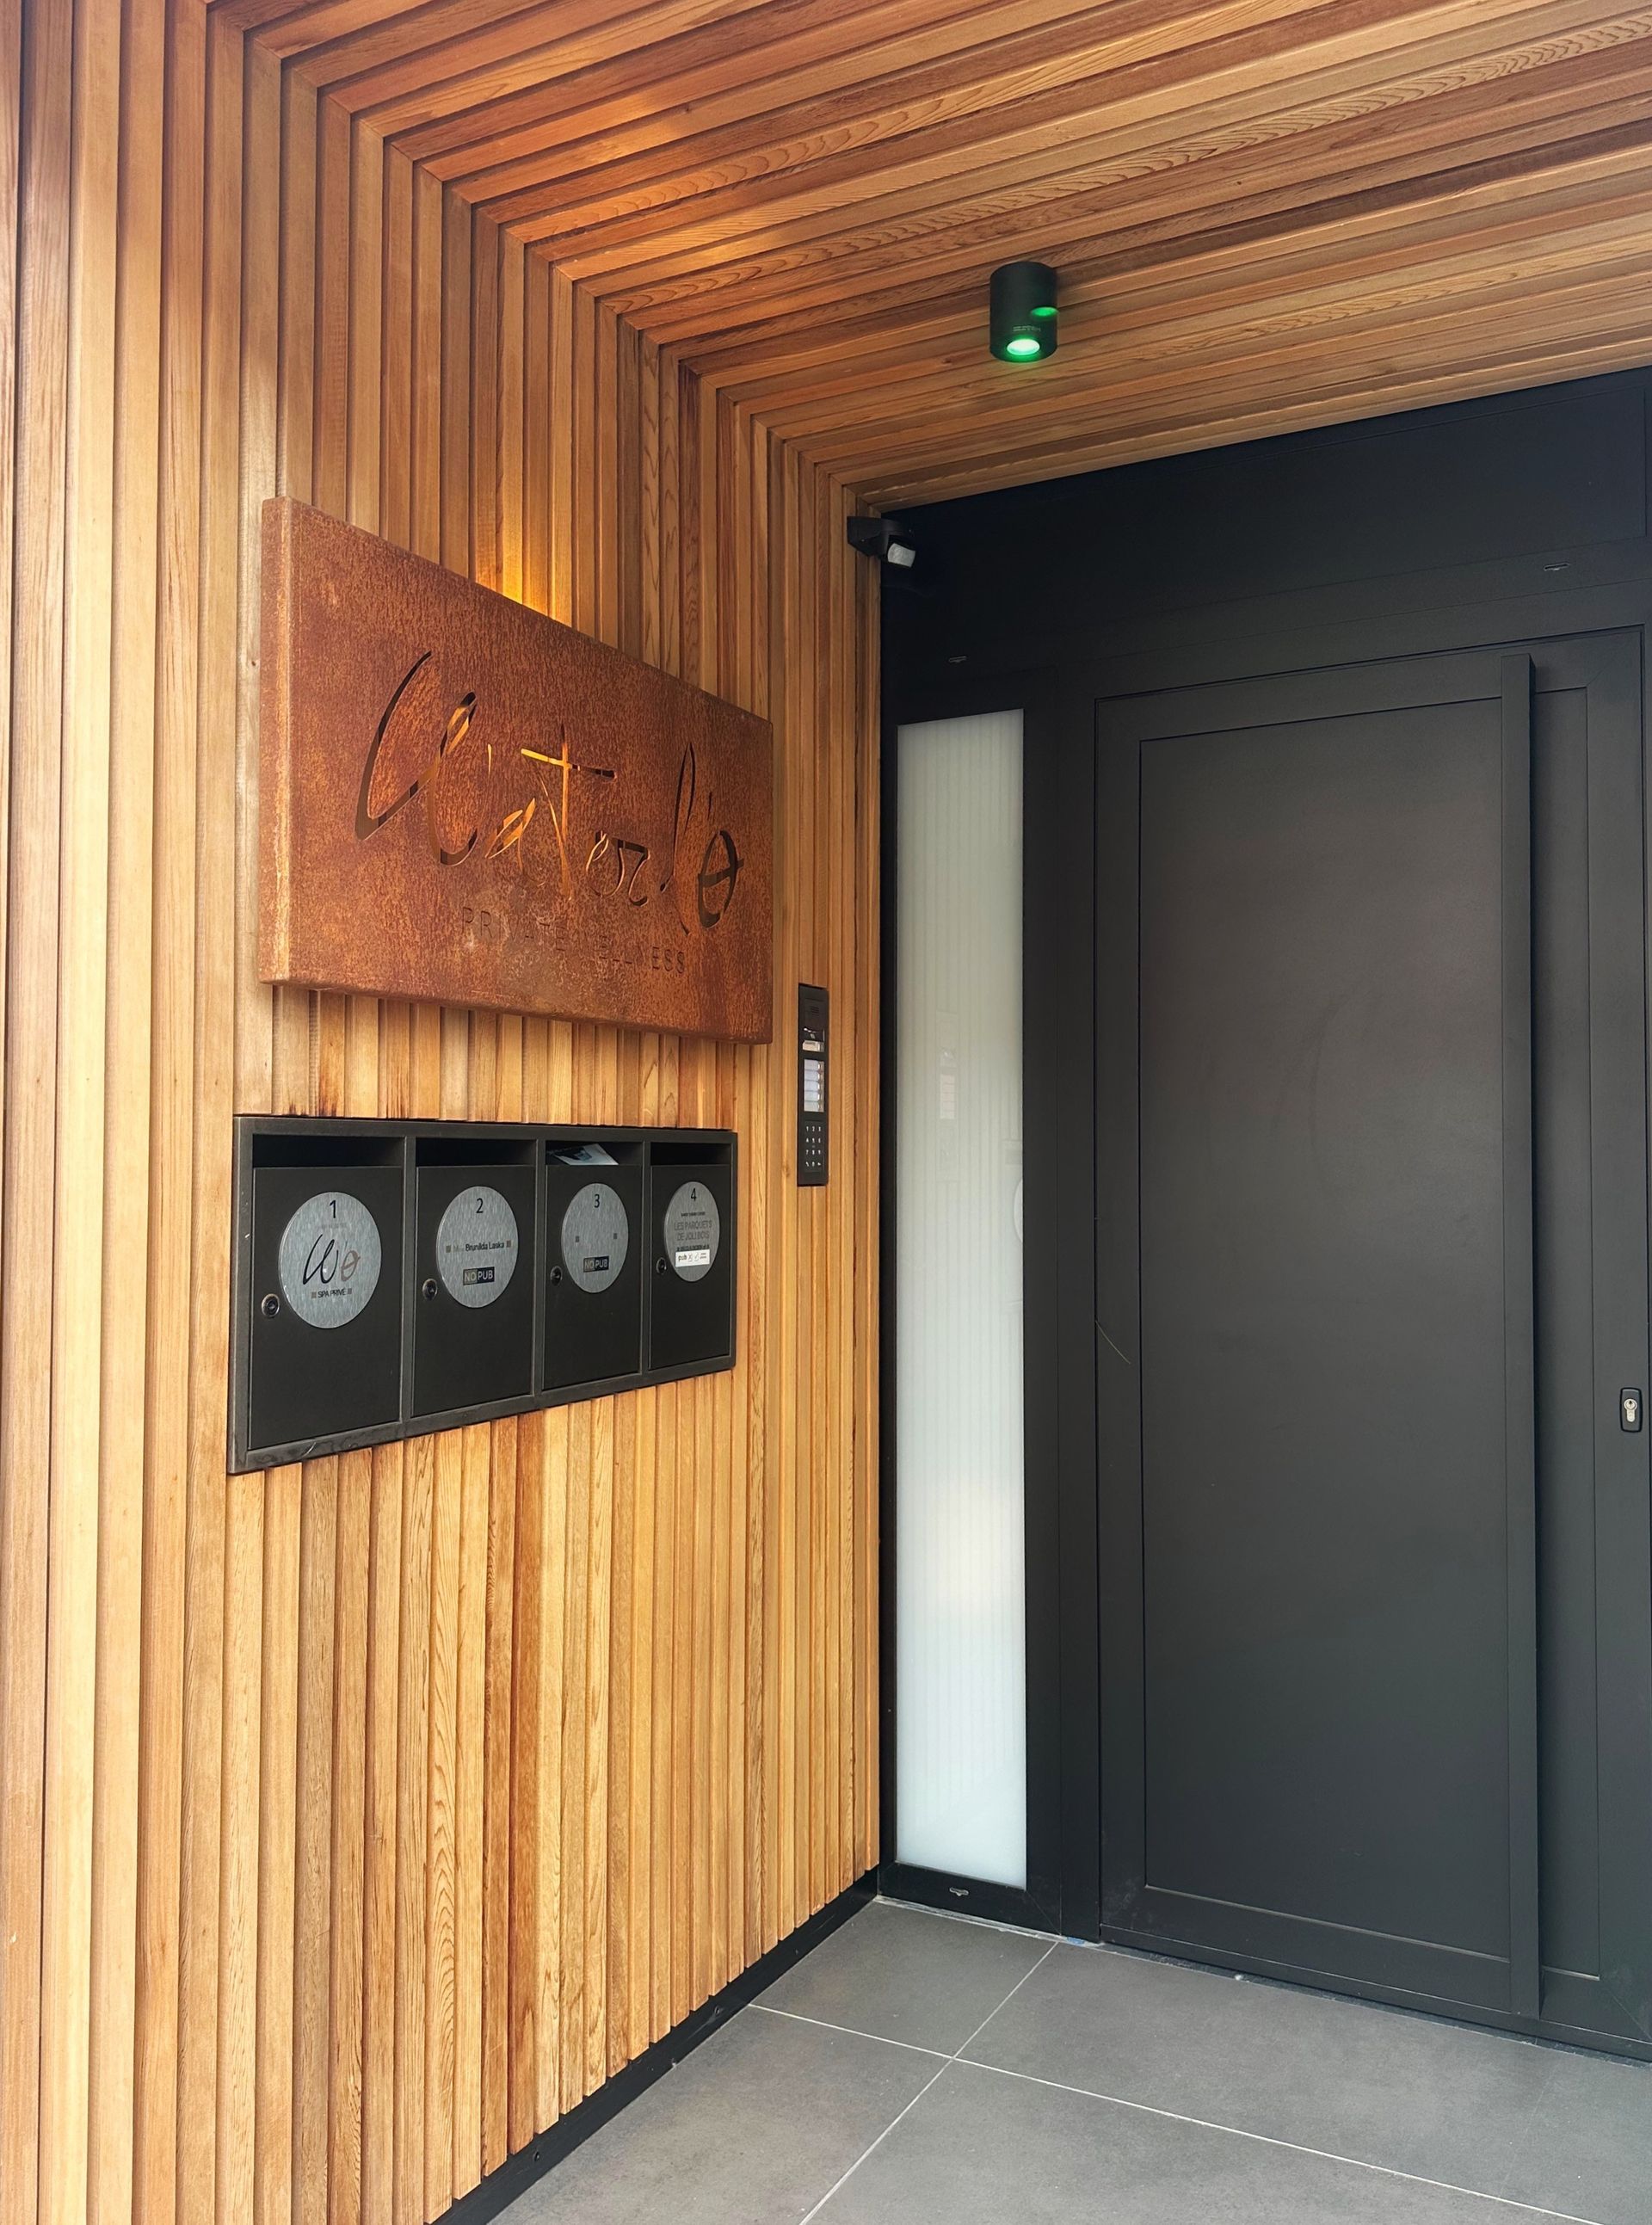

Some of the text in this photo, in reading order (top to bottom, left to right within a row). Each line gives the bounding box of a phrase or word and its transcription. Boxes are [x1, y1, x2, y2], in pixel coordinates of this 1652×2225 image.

[594, 1193, 601, 1208] 3
[690, 1187, 697, 1201] 4
[330, 1199, 336, 1218] 1
[476, 1198, 484, 1214] 2
[584, 1258, 608, 1271] NO PUB
[464, 1269, 494, 1282] NO PUB
